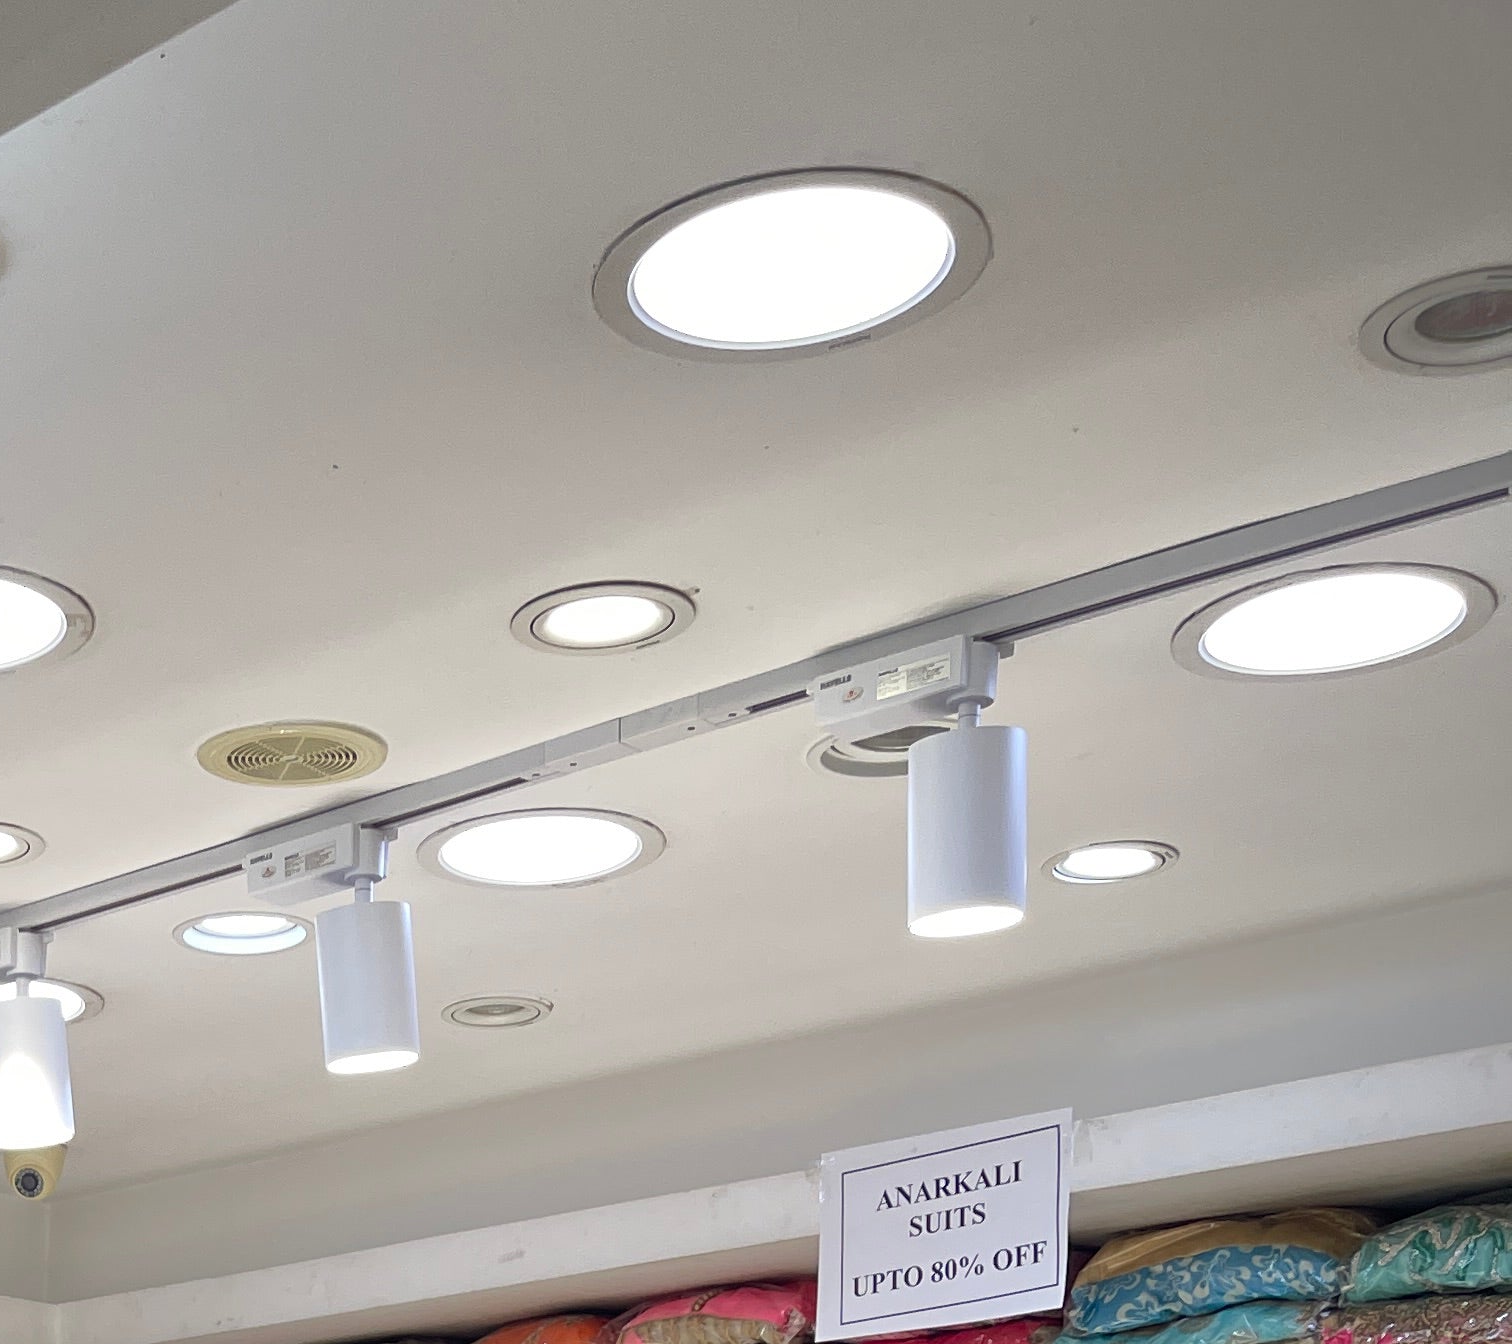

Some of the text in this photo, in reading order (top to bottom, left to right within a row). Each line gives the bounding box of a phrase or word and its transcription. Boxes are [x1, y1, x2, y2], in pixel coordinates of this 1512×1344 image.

[876, 1160, 1023, 1211] ANARKALI
[908, 1203, 987, 1238] SUITS
[852, 1240, 1048, 1297] UPTO 80% OFF
